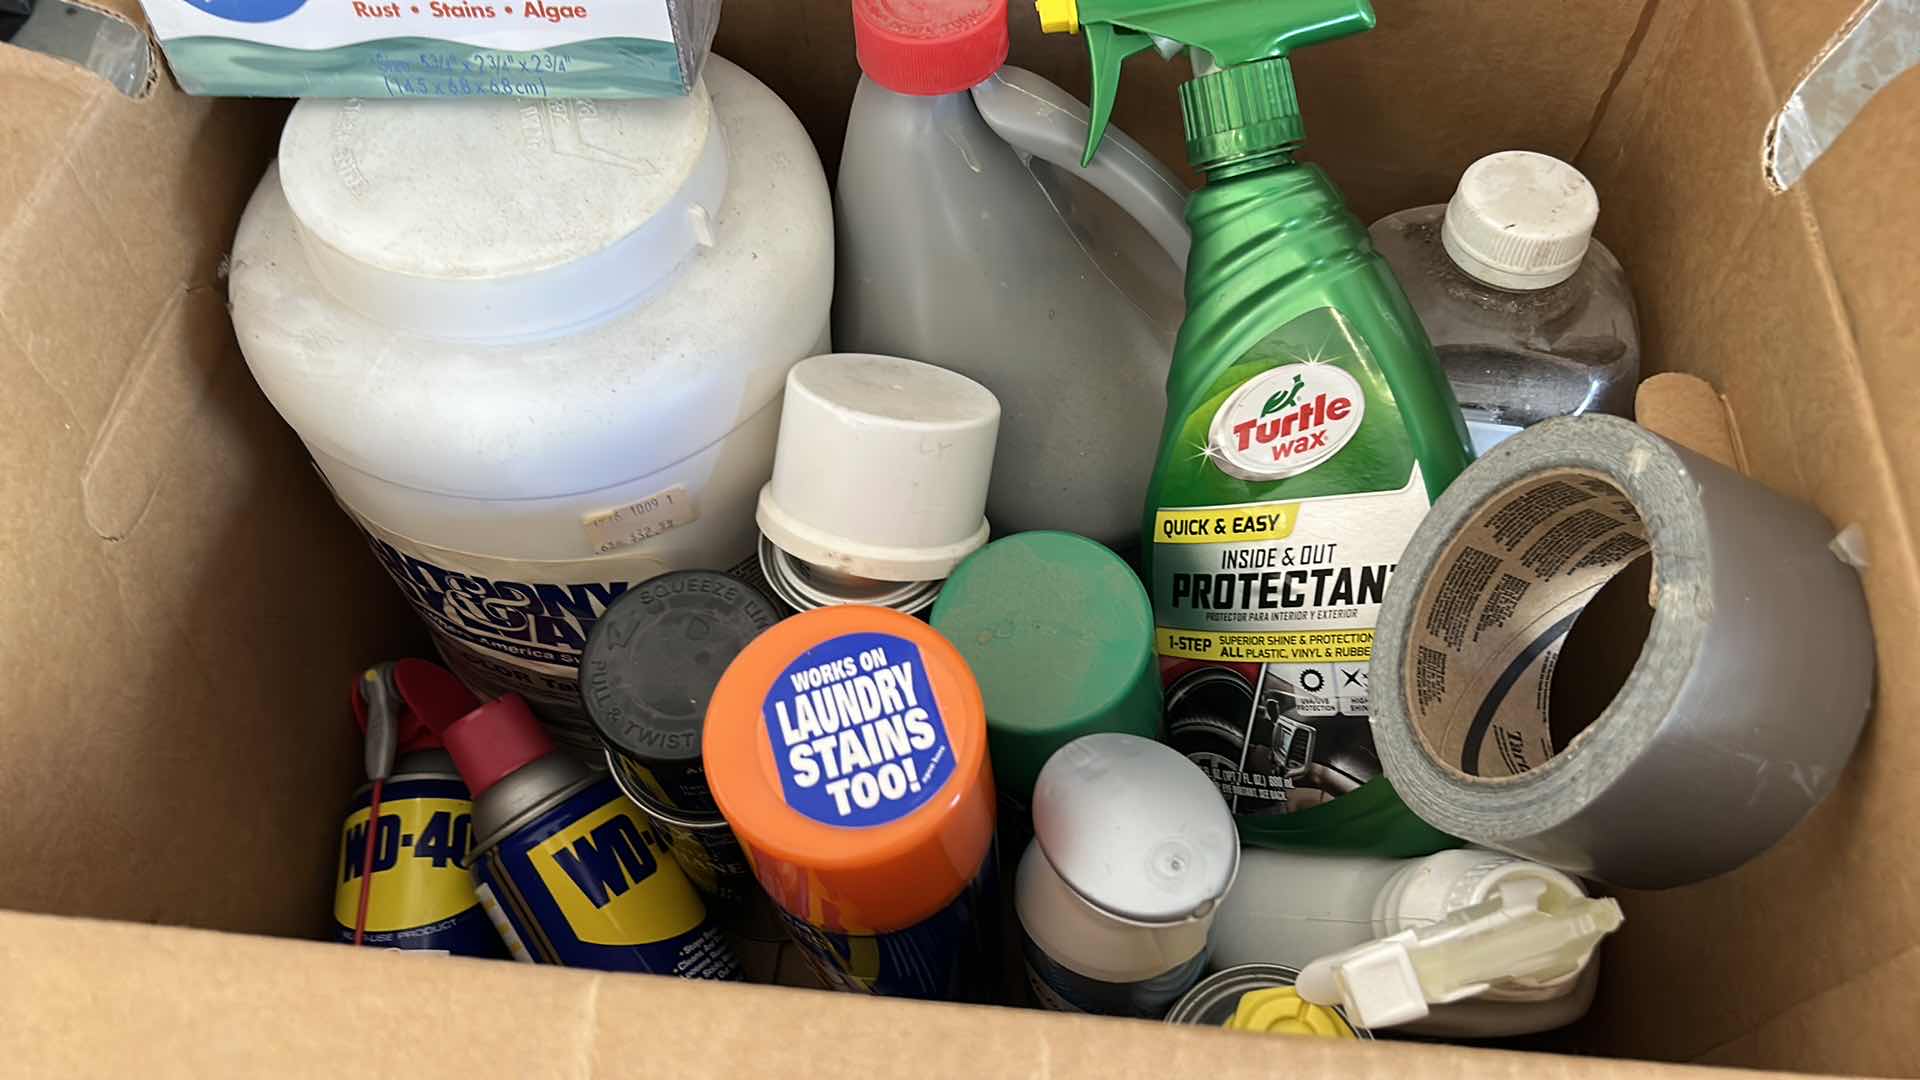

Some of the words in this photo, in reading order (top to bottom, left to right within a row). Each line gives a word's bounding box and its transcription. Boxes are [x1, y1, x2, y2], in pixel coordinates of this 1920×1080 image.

[352, 0, 400, 18] Rust
[429, 0, 496, 18] Stains
[524, 0, 588, 22] Algae
[519, 60, 529, 73] x
[1234, 393, 1352, 452] Turtle
[1271, 429, 1329, 461] wax
[1163, 518, 1209, 538] QUICK
[1214, 518, 1226, 534] &
[1232, 514, 1280, 532] EASY
[1221, 548, 1277, 570] INSIDE
[1282, 547, 1295, 566] &
[1300, 543, 1338, 565] OUT
[640, 577, 737, 605] SQUEEZE
[1205, 612, 1247, 622] PROTECTOR
[1249, 611, 1269, 622] PARA
[1271, 610, 1309, 622] INTERIOR
[1309, 610, 1316, 620] Y
[1317, 608, 1358, 620] EXTERIOR
[1169, 635, 1212, 653] 1-STEP
[1219, 635, 1266, 646] SUPERIOR
[1267, 634, 1298, 646] SHINE
[1299, 634, 1307, 645] &
[1309, 632, 1374, 645] PROTECTION
[1220, 646, 1244, 658] ALL
[1246, 648, 1289, 660] PLASTIC,
[1291, 646, 1323, 659] VINYL
[1324, 646, 1333, 658] &
[1335, 645, 1372, 658] RUBBE
[592, 660, 611, 703] PULL
[790, 656, 858, 694] WORKS
[858, 647, 888, 673] ON
[775, 661, 919, 747] LAUNDRY
[624, 721, 695, 750] TWIST
[788, 706, 937, 789] STAINS
[825, 757, 922, 817] TOO!
[397, 918, 457, 938] PRODUCT
